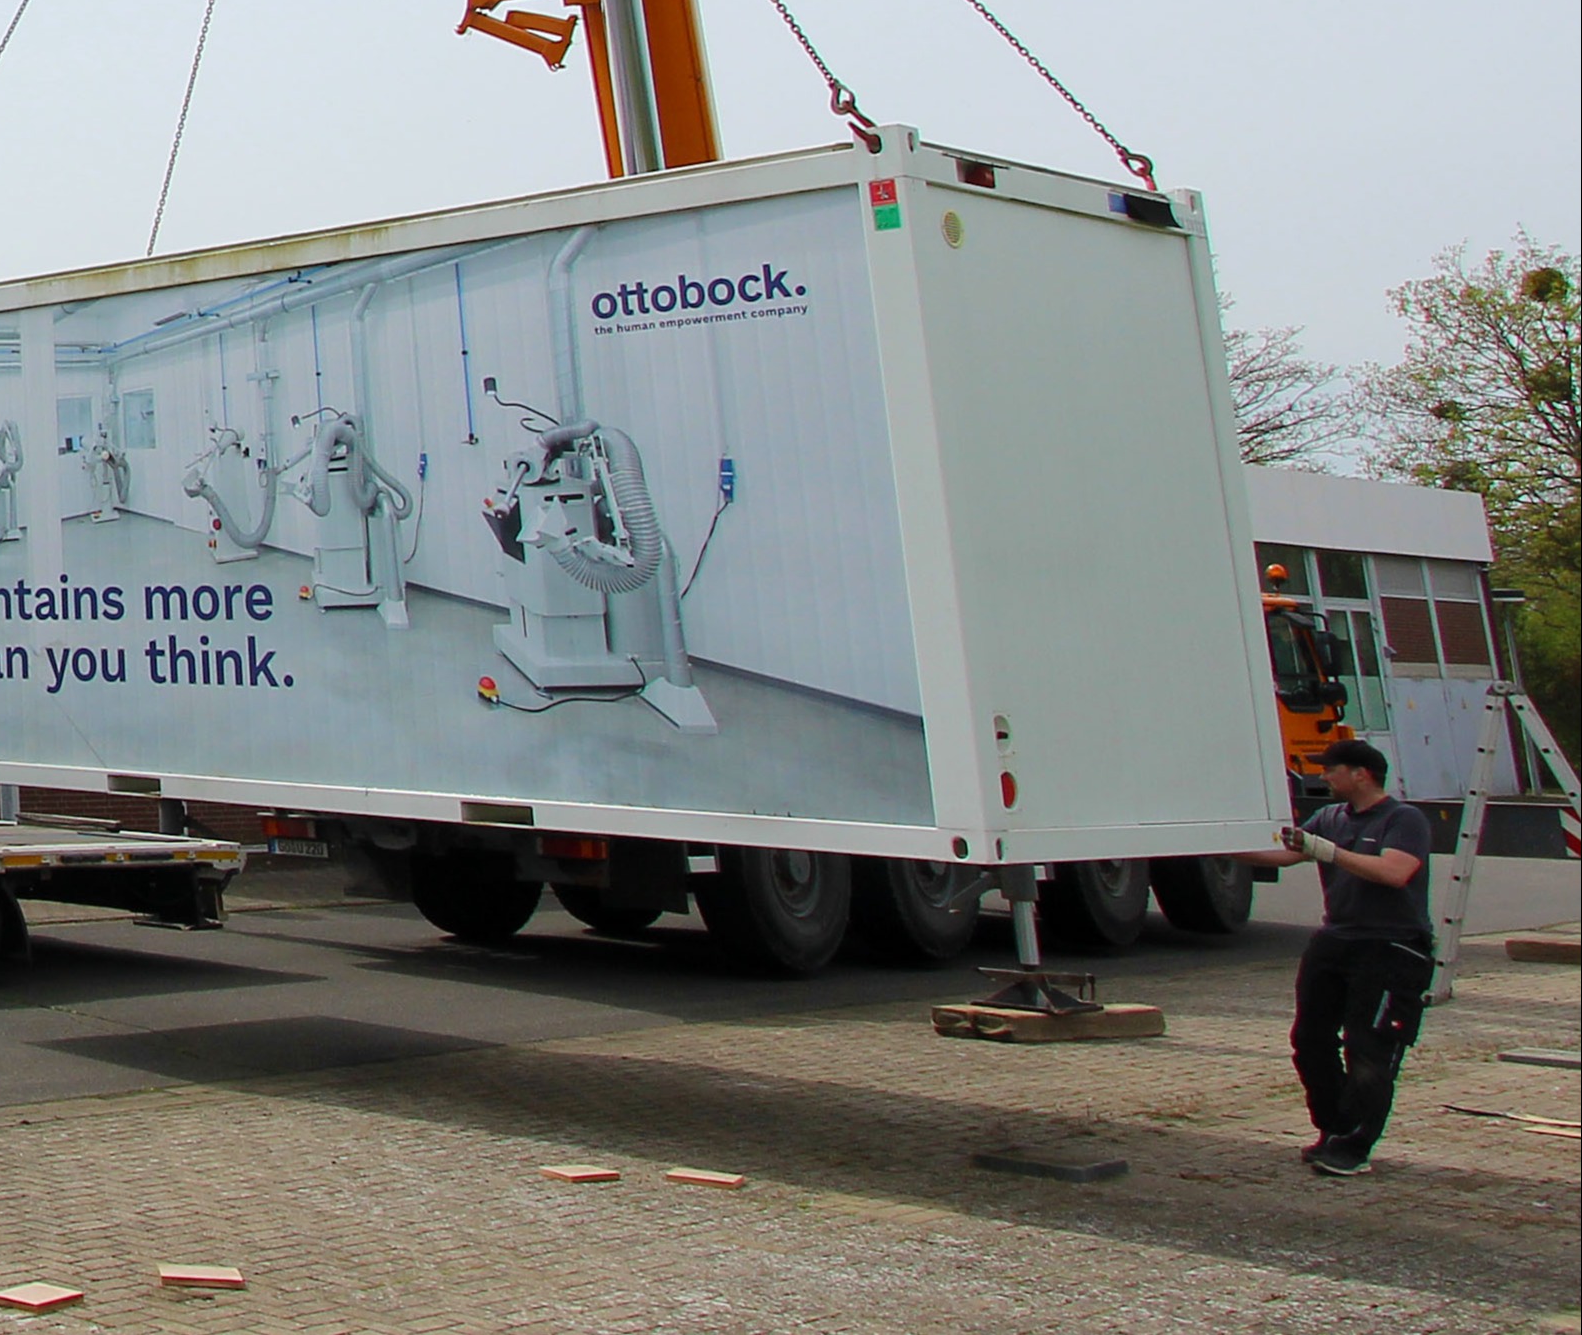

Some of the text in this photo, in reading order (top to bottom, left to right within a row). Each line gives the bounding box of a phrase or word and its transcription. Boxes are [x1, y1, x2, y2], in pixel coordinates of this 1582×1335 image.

[592, 264, 806, 319] ottobock.
[594, 304, 808, 336] the human empowerment company
[144, 584, 273, 621] more
[46, 646, 126, 694] you
[144, 635, 294, 688] think.
